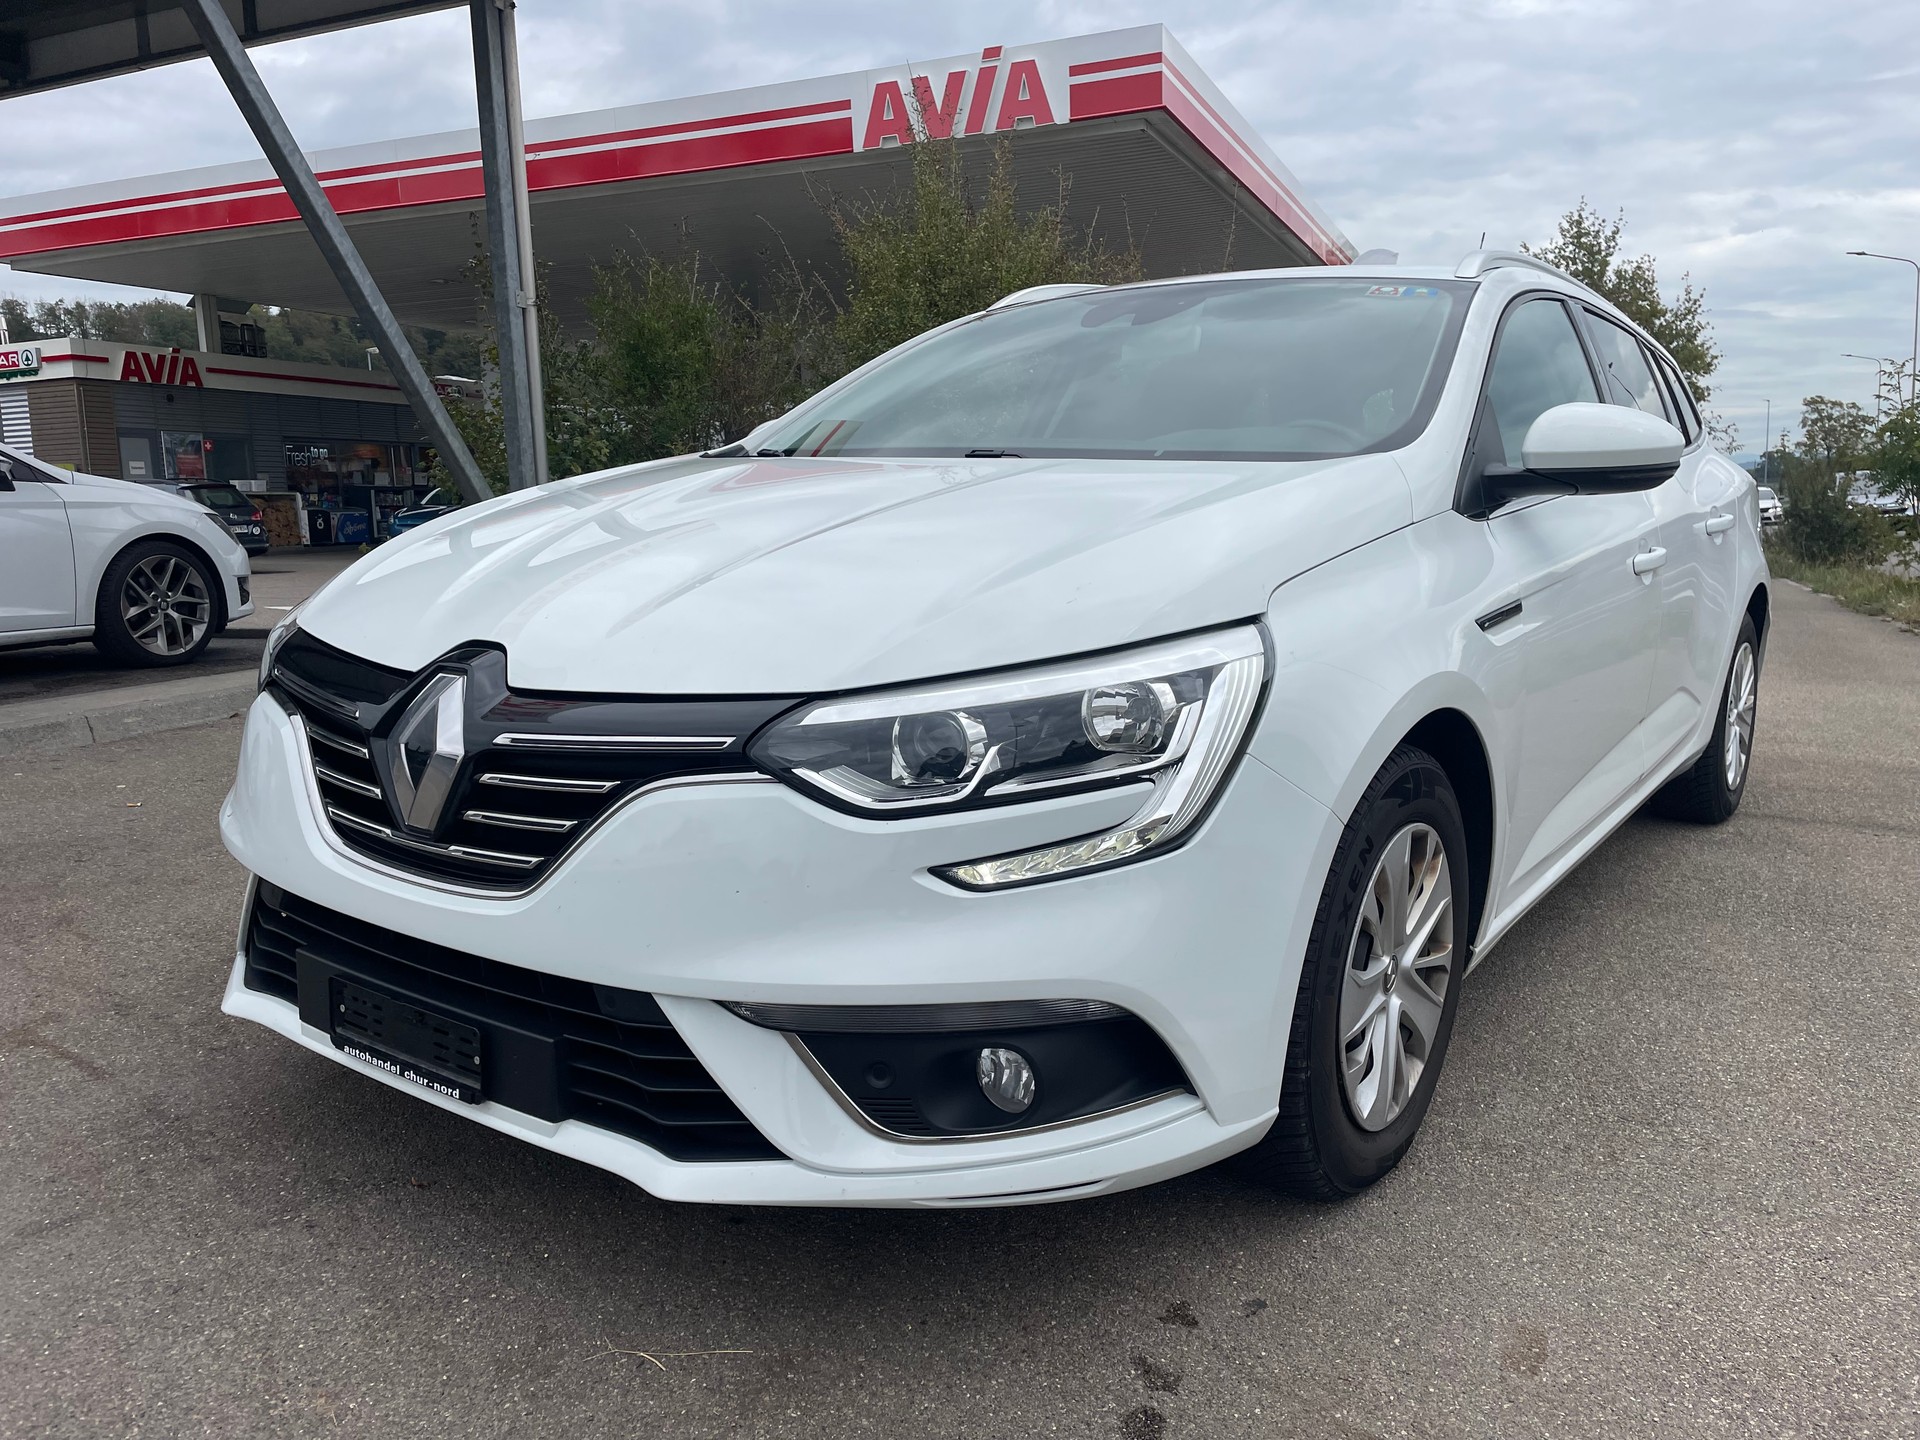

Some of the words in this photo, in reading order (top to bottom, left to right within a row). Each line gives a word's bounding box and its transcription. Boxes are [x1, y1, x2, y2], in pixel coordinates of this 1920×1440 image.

[285, 445, 311, 466] Fresh
[1325, 834, 1375, 996] NEXEN
[343, 1044, 400, 1075] autohandel
[404, 1070, 460, 1099] chur-nord
